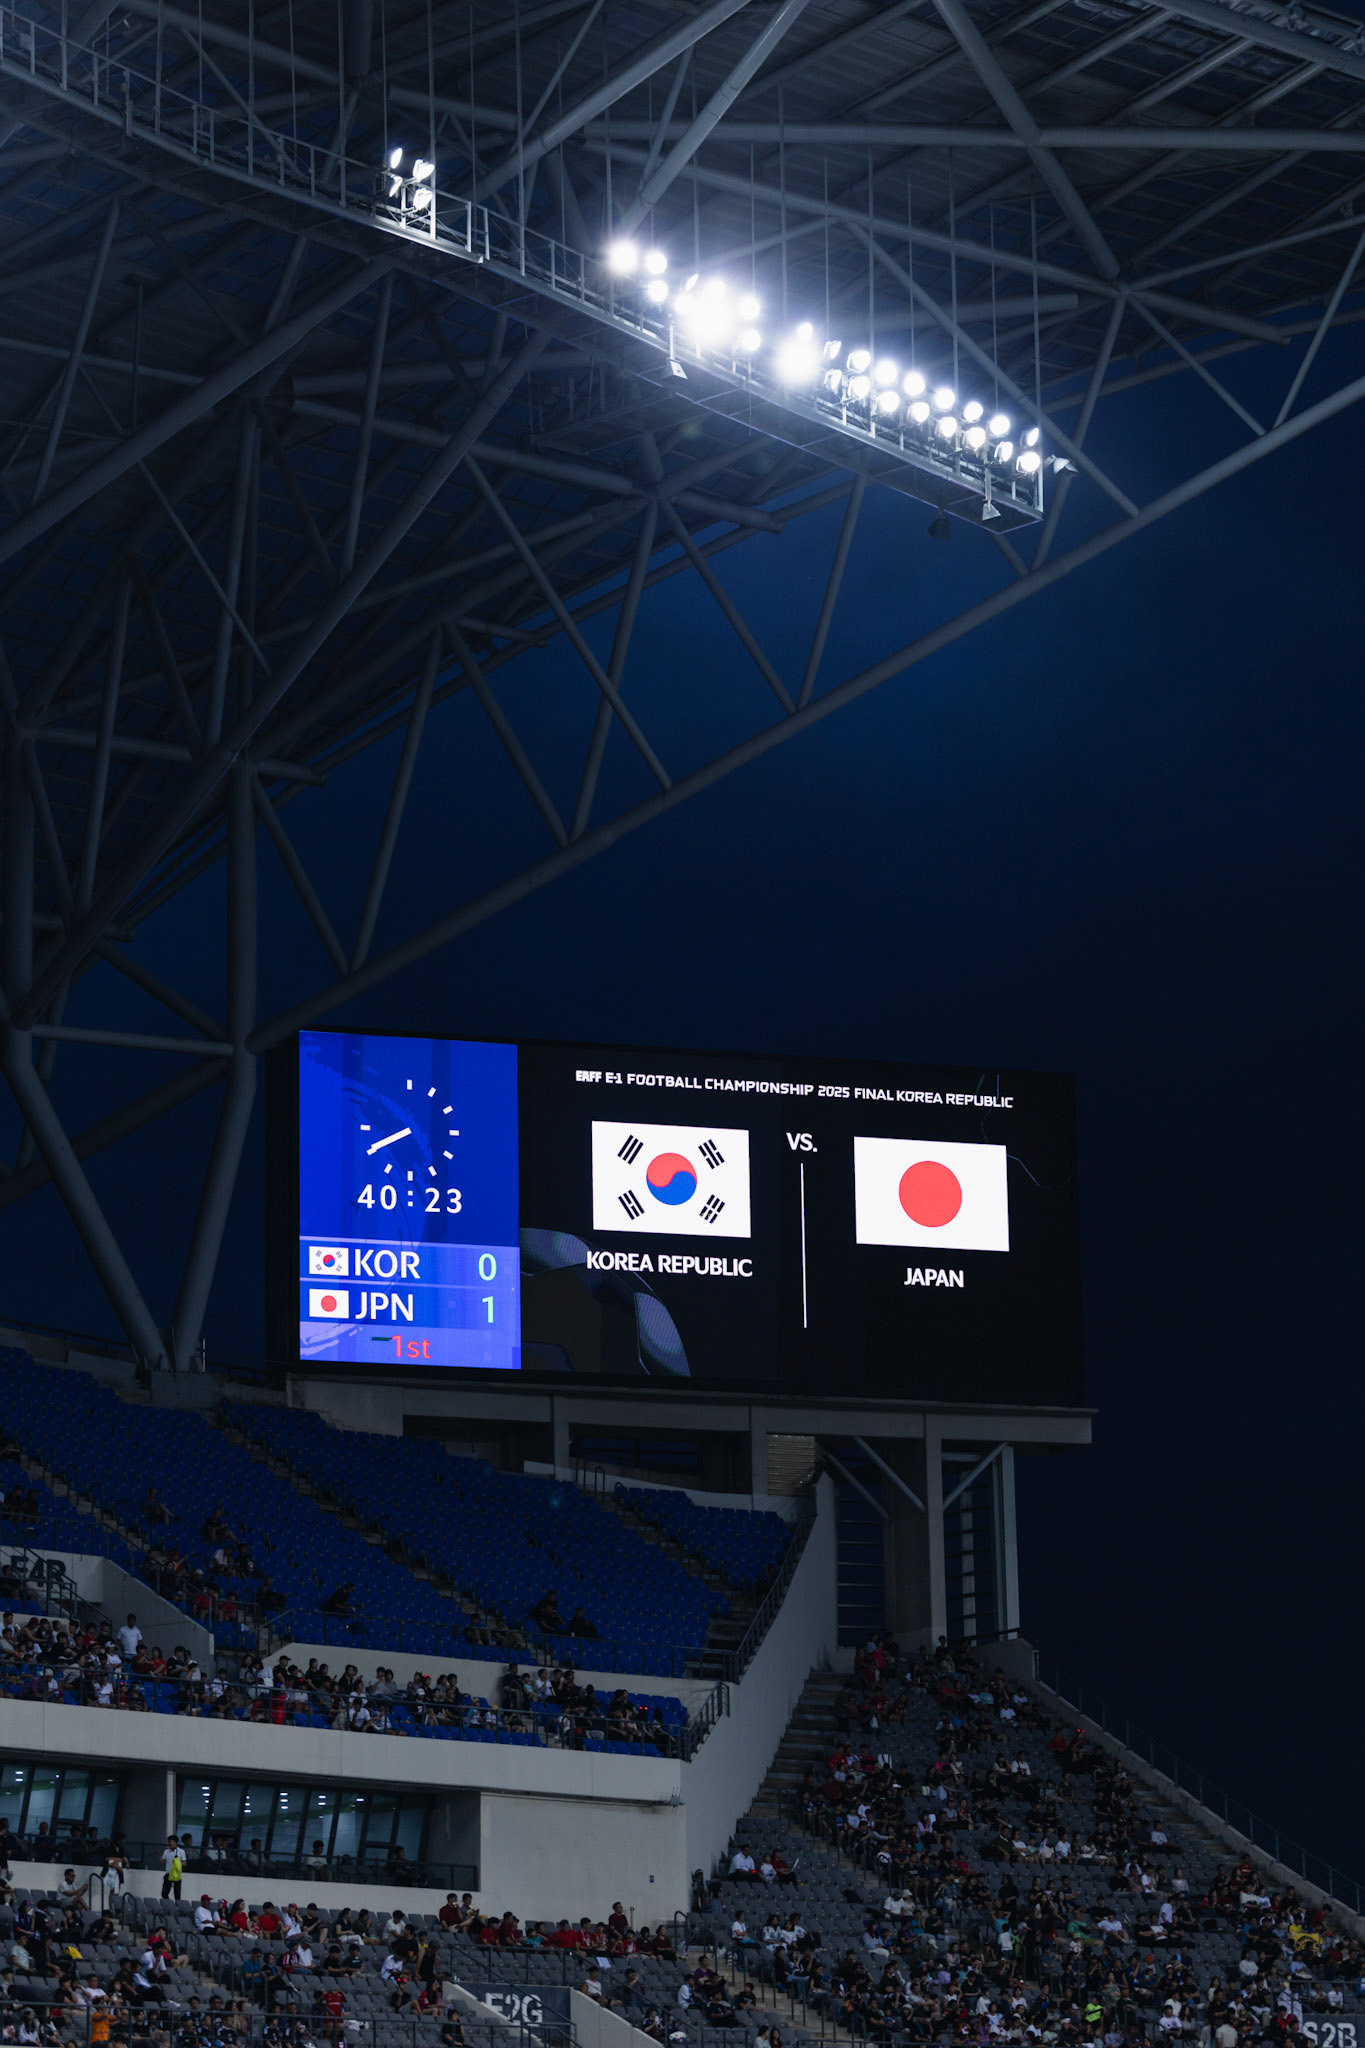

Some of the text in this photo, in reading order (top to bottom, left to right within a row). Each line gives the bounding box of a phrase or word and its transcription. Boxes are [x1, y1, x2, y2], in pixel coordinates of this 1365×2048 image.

[575, 1069, 1014, 1109] EAFF E-1 FOOTBALL CHAMPIONSHIP 2025 FINAL KOREA REPUBLIC
[786, 1132, 818, 1153] VS.
[354, 1249, 497, 1282] KOR 0
[586, 1250, 754, 1278] KOREA REPUBLIC
[903, 1267, 964, 1288] JAPAN
[355, 1291, 494, 1324] JPN 1
[391, 1335, 431, 1359] 1st
